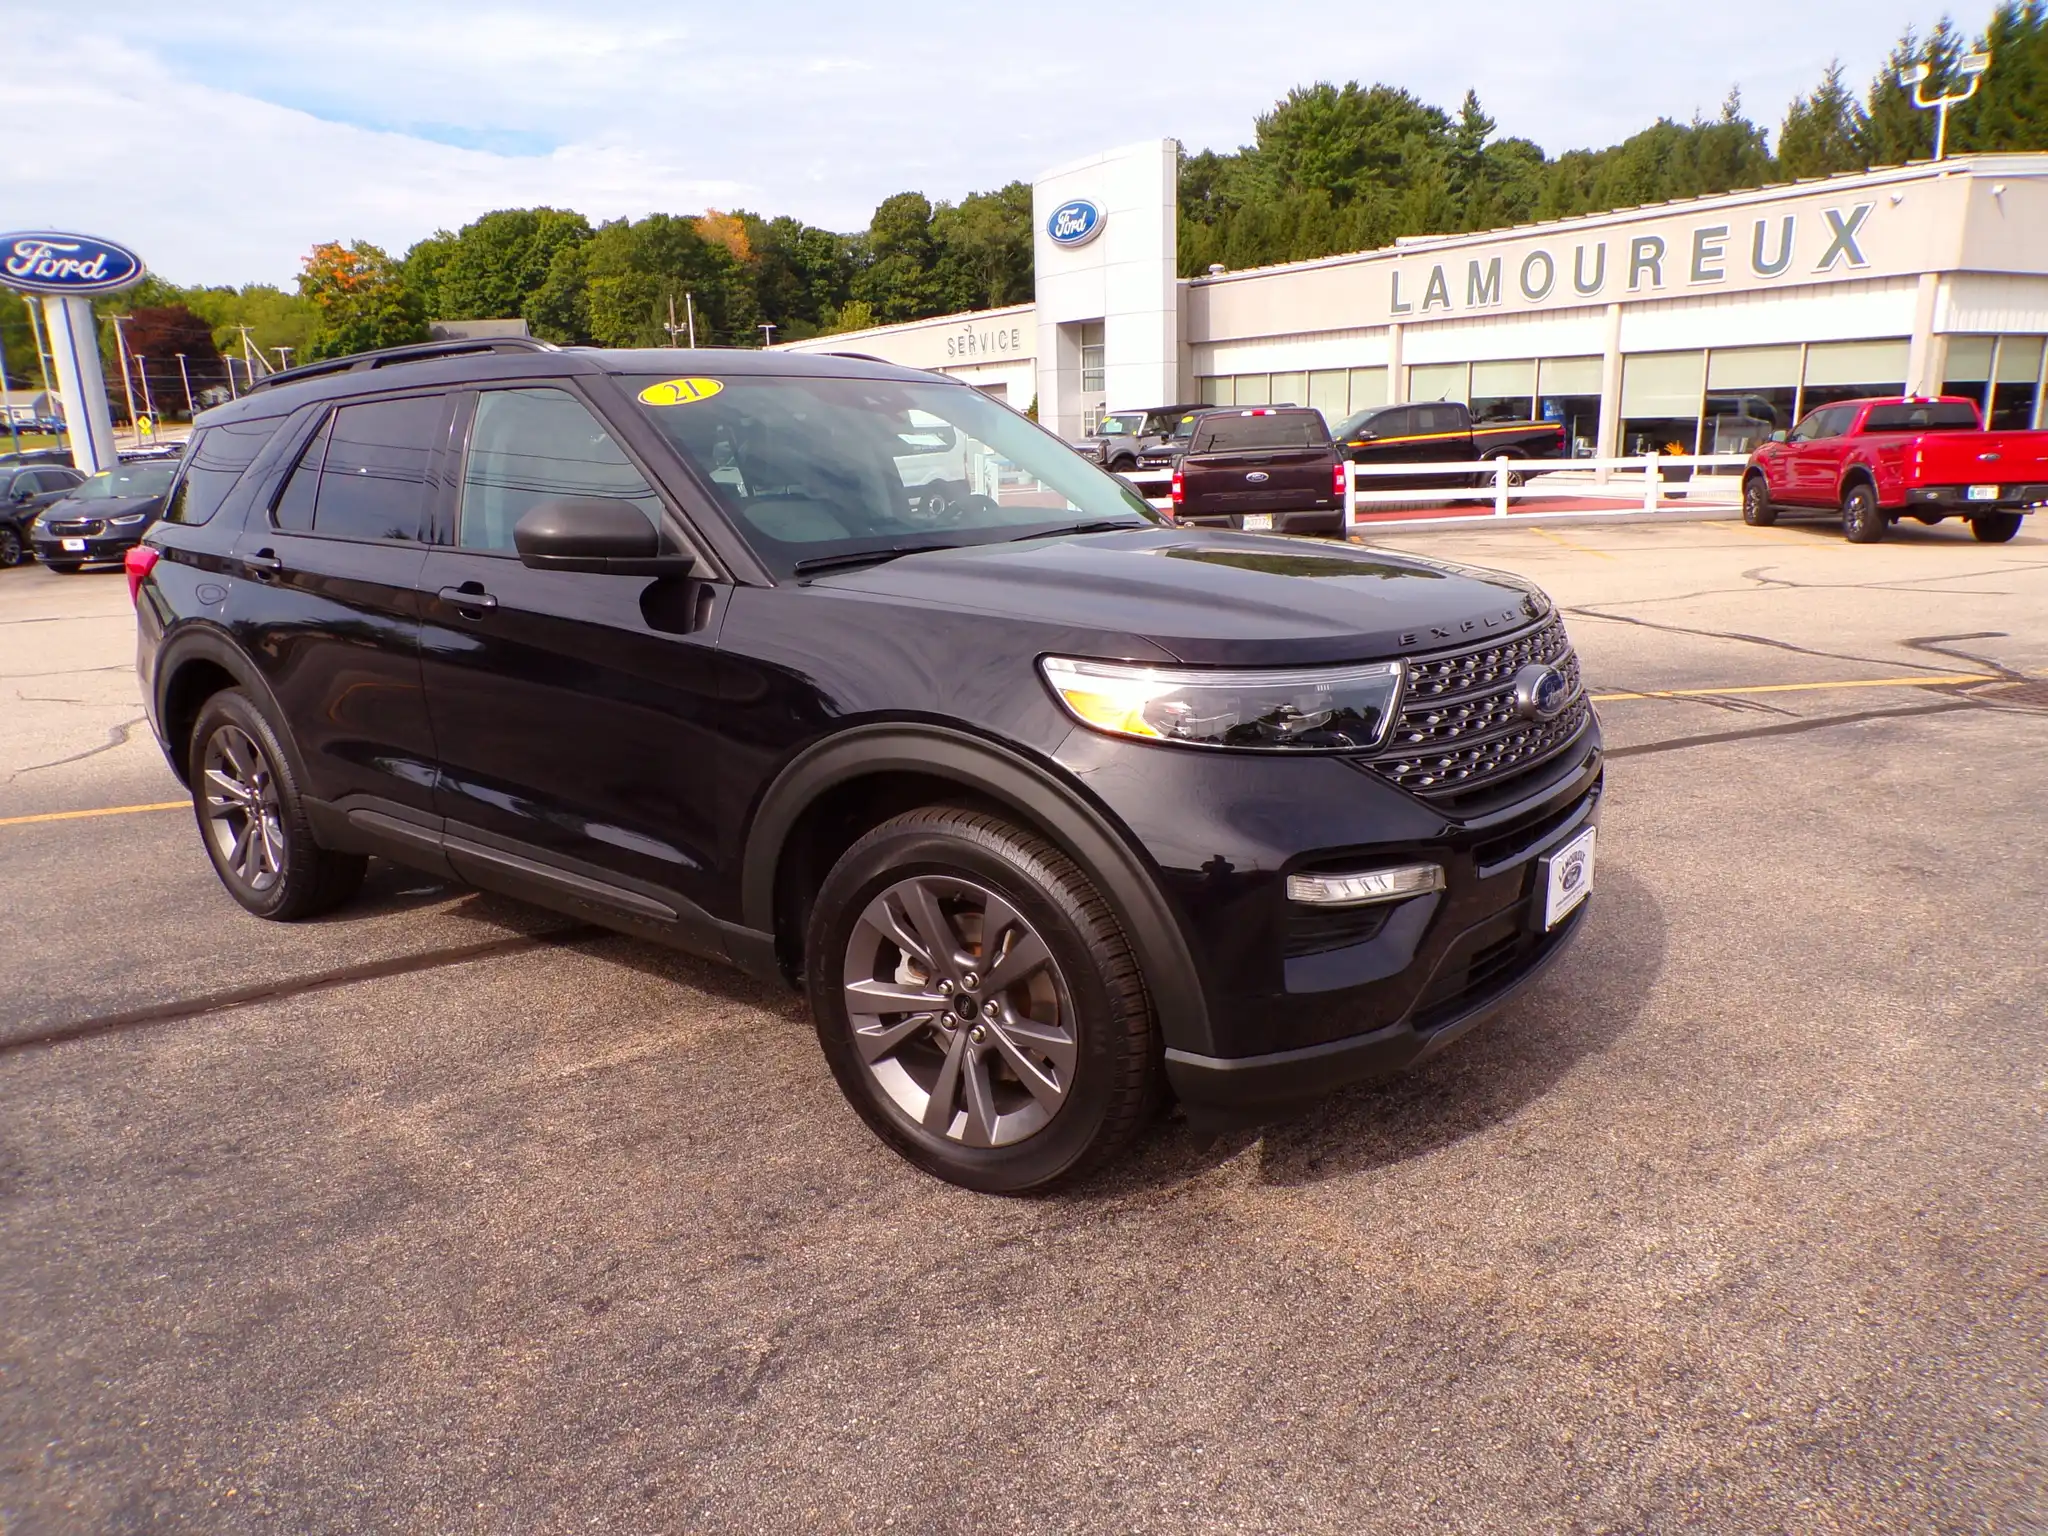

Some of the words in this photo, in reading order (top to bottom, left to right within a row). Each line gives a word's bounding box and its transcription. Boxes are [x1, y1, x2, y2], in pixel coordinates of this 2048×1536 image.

[1055, 207, 1088, 237] Ford
[6, 240, 108, 279] Ford
[1390, 203, 1875, 314] LAMOUREUX
[947, 328, 1020, 356] SERVICE
[663, 380, 701, 402] 21
